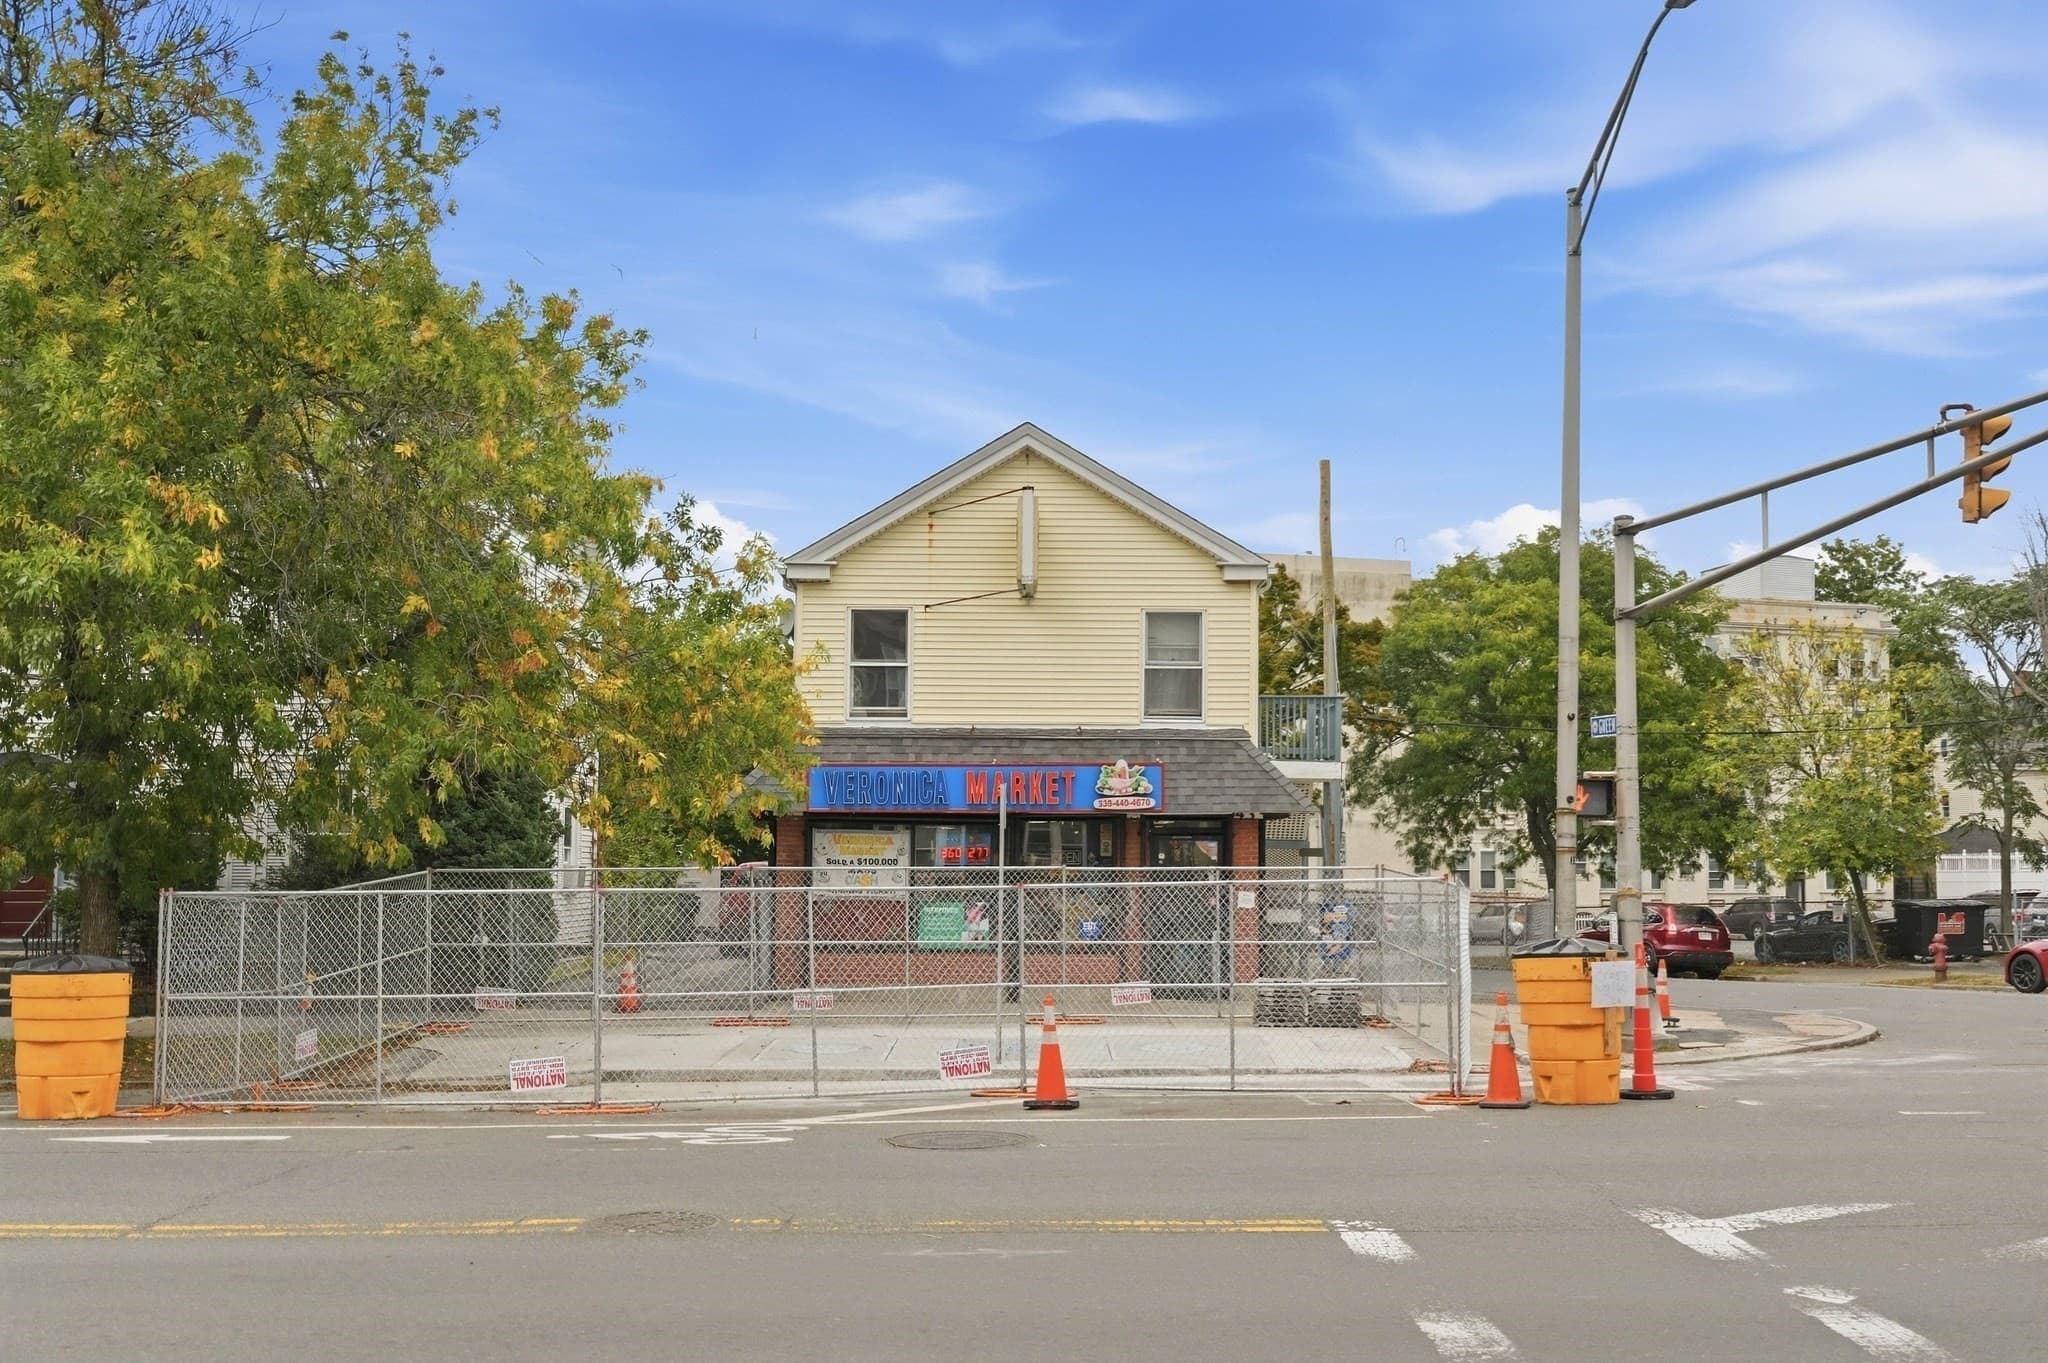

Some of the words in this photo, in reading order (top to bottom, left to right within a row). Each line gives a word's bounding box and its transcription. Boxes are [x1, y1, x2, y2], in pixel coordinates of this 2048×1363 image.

[823, 769, 949, 805] VERONICA
[966, 770, 1076, 805] MARKET
[797, 999, 833, 1009] NATINAL
[1113, 992, 1152, 1003] NATIONAL
[942, 1060, 991, 1077] NATIONAL
[513, 1073, 565, 1089] NATIONAL
